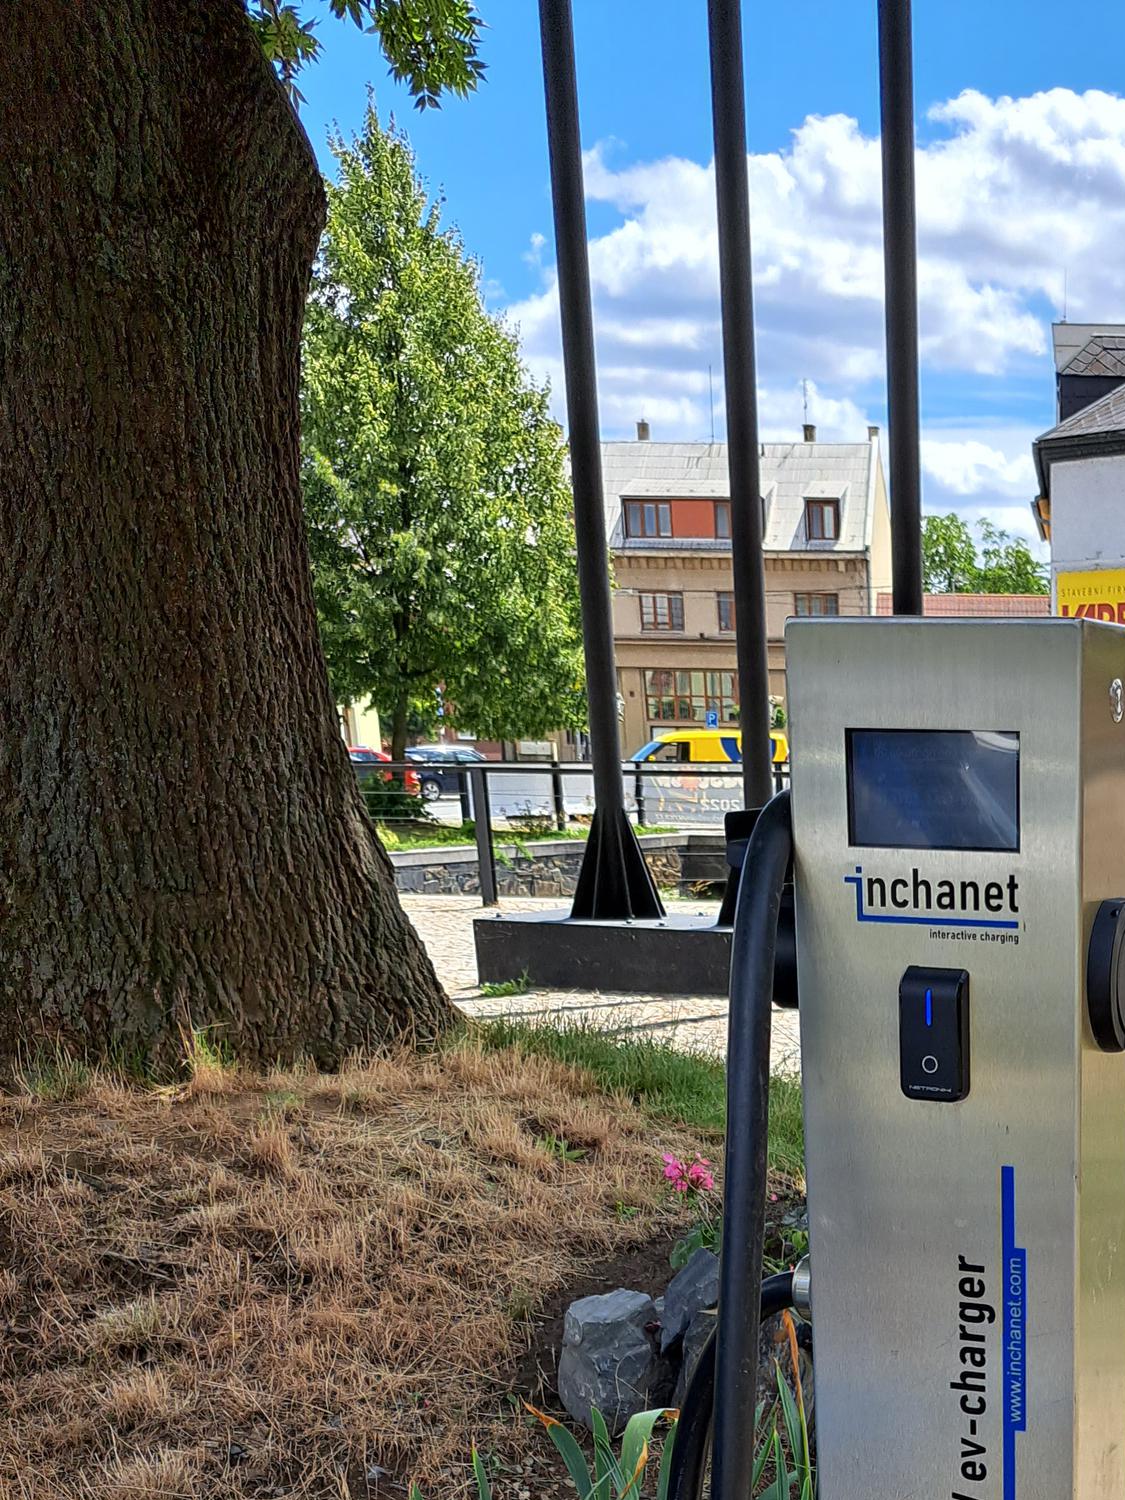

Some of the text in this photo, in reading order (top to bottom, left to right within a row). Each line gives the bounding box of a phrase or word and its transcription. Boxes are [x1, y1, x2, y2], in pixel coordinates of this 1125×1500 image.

[844, 866, 1020, 914] inchanet
[929, 928, 1020, 946] interactive charging
[949, 1254, 996, 1482] ev-charger
[1006, 1257, 1022, 1423] www.inchanet.com
